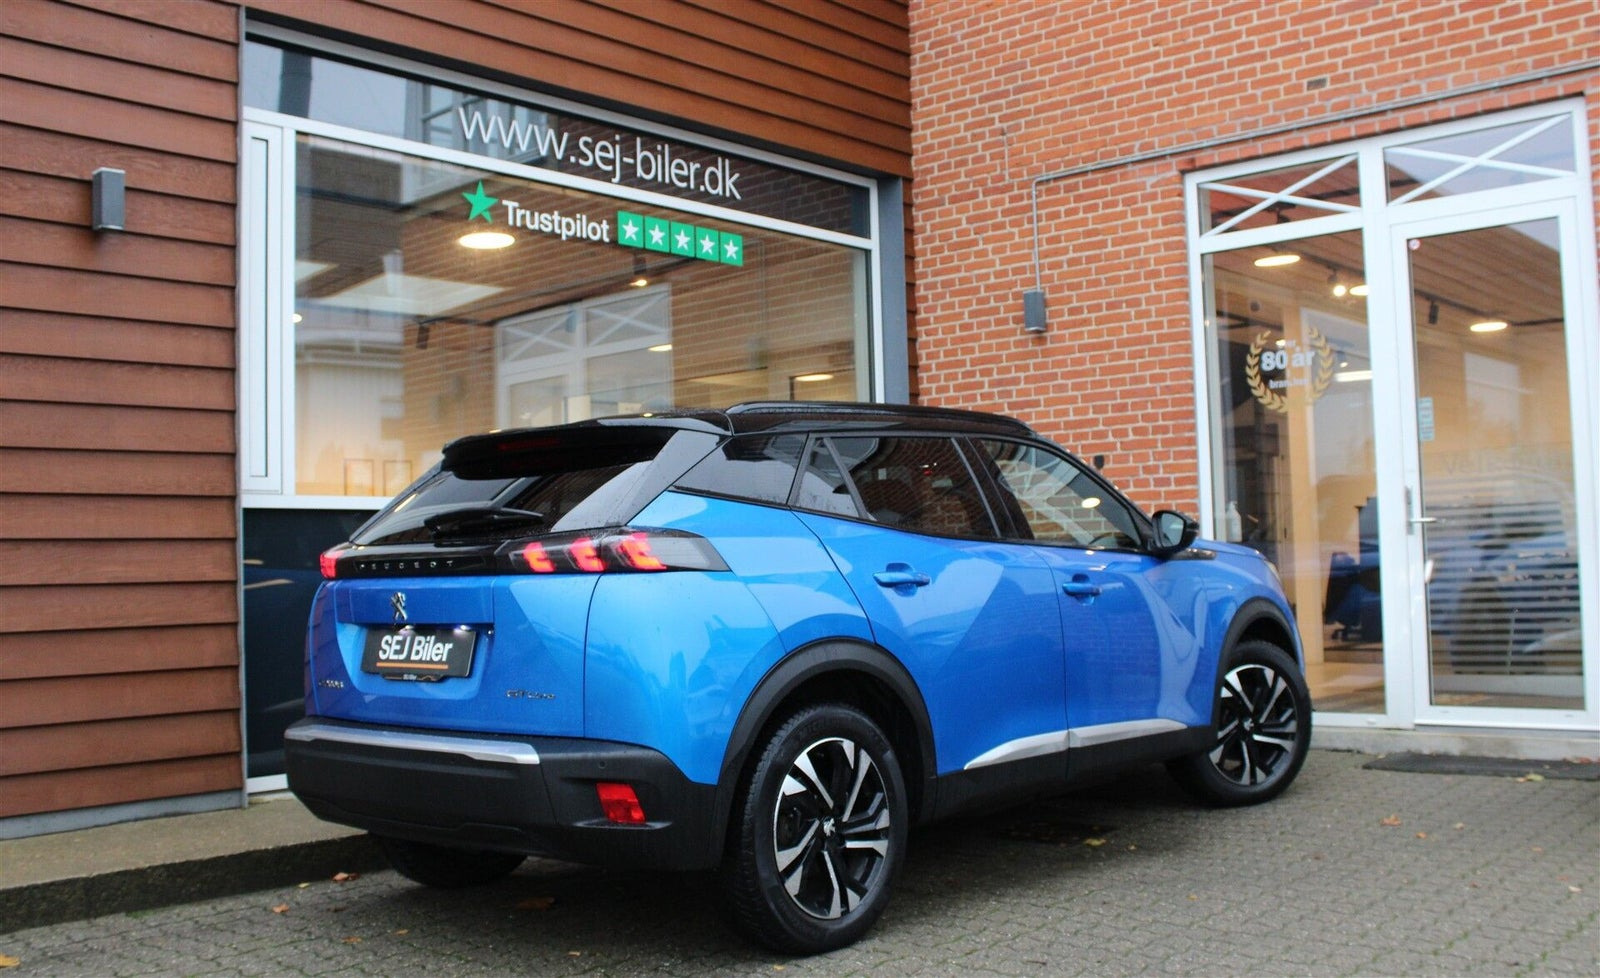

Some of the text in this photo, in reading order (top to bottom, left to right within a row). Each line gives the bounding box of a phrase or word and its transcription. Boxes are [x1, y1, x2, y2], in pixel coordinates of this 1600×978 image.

[458, 106, 742, 200] www.sej-biler.dk
[502, 199, 611, 243] Trustpilot
[1261, 345, 1315, 371] 80 år
[378, 634, 454, 662] SEJ Biler
